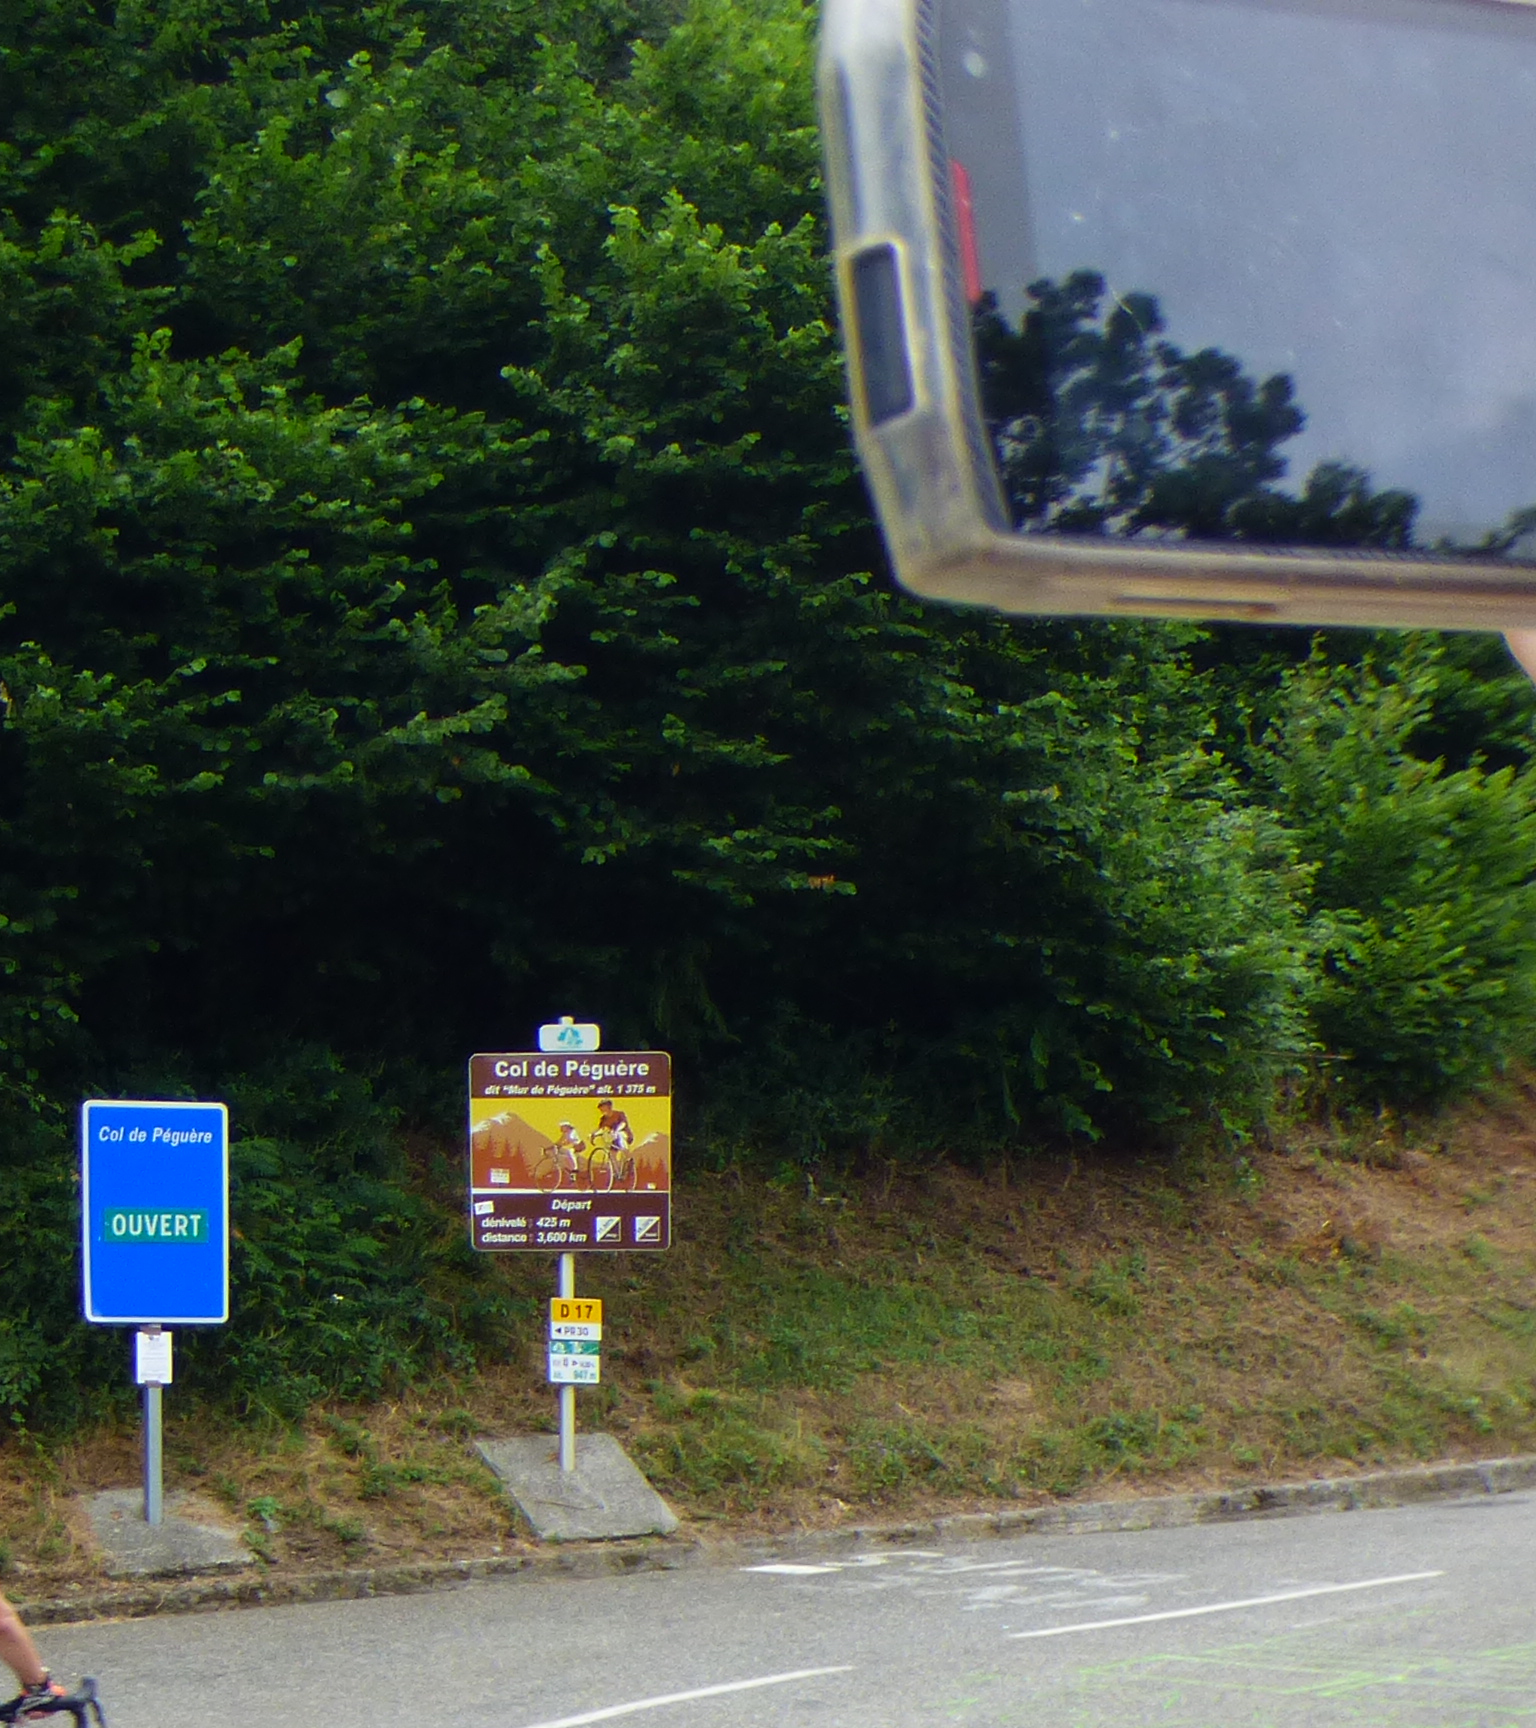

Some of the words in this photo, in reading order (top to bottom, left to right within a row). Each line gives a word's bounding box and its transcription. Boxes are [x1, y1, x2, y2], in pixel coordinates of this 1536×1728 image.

[495, 1061, 527, 1077] Col
[534, 1061, 559, 1077] de
[565, 1060, 649, 1080] Péguère
[99, 1126, 124, 1142] Col
[129, 1127, 147, 1143] de
[152, 1127, 213, 1147] Péguère
[552, 1199, 593, 1212] Départ
[112, 1213, 202, 1237] OUVERT
[561, 1304, 569, 1318] D
[575, 1305, 593, 1318] 17
